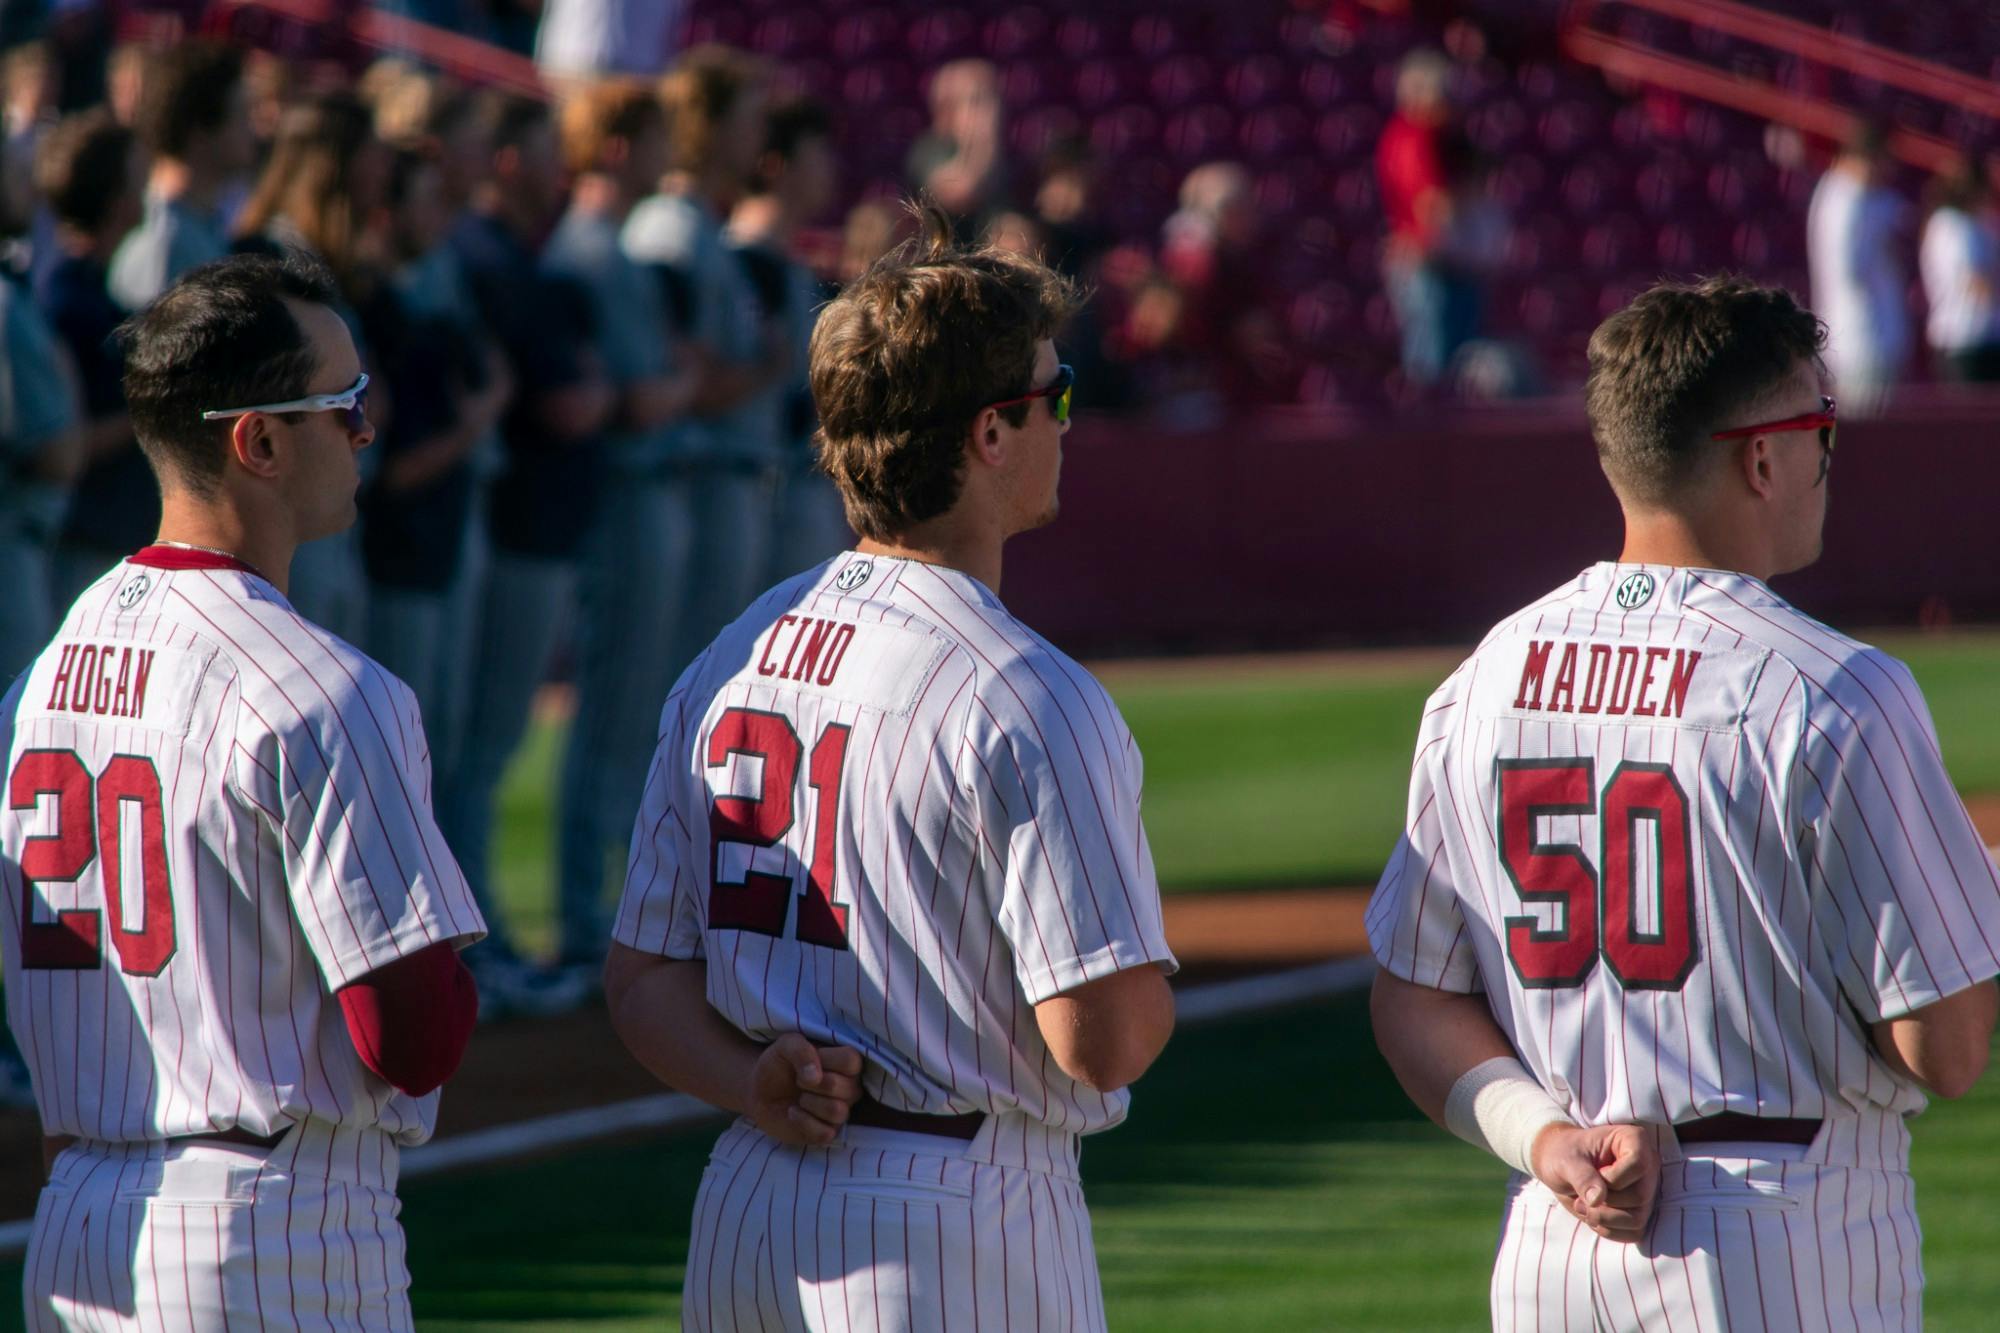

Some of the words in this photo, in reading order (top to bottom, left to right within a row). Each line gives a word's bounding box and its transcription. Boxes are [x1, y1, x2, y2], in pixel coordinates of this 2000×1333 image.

[119, 576, 148, 607] SEC
[838, 562, 869, 589] SEC
[1618, 575, 1651, 607] SEC
[47, 643, 155, 719] HOGAN
[758, 614, 856, 686] CINO
[1513, 640, 1702, 718] MADDEN
[10, 748, 178, 978] 20
[708, 707, 851, 951] 21
[1497, 756, 1698, 991] 50
